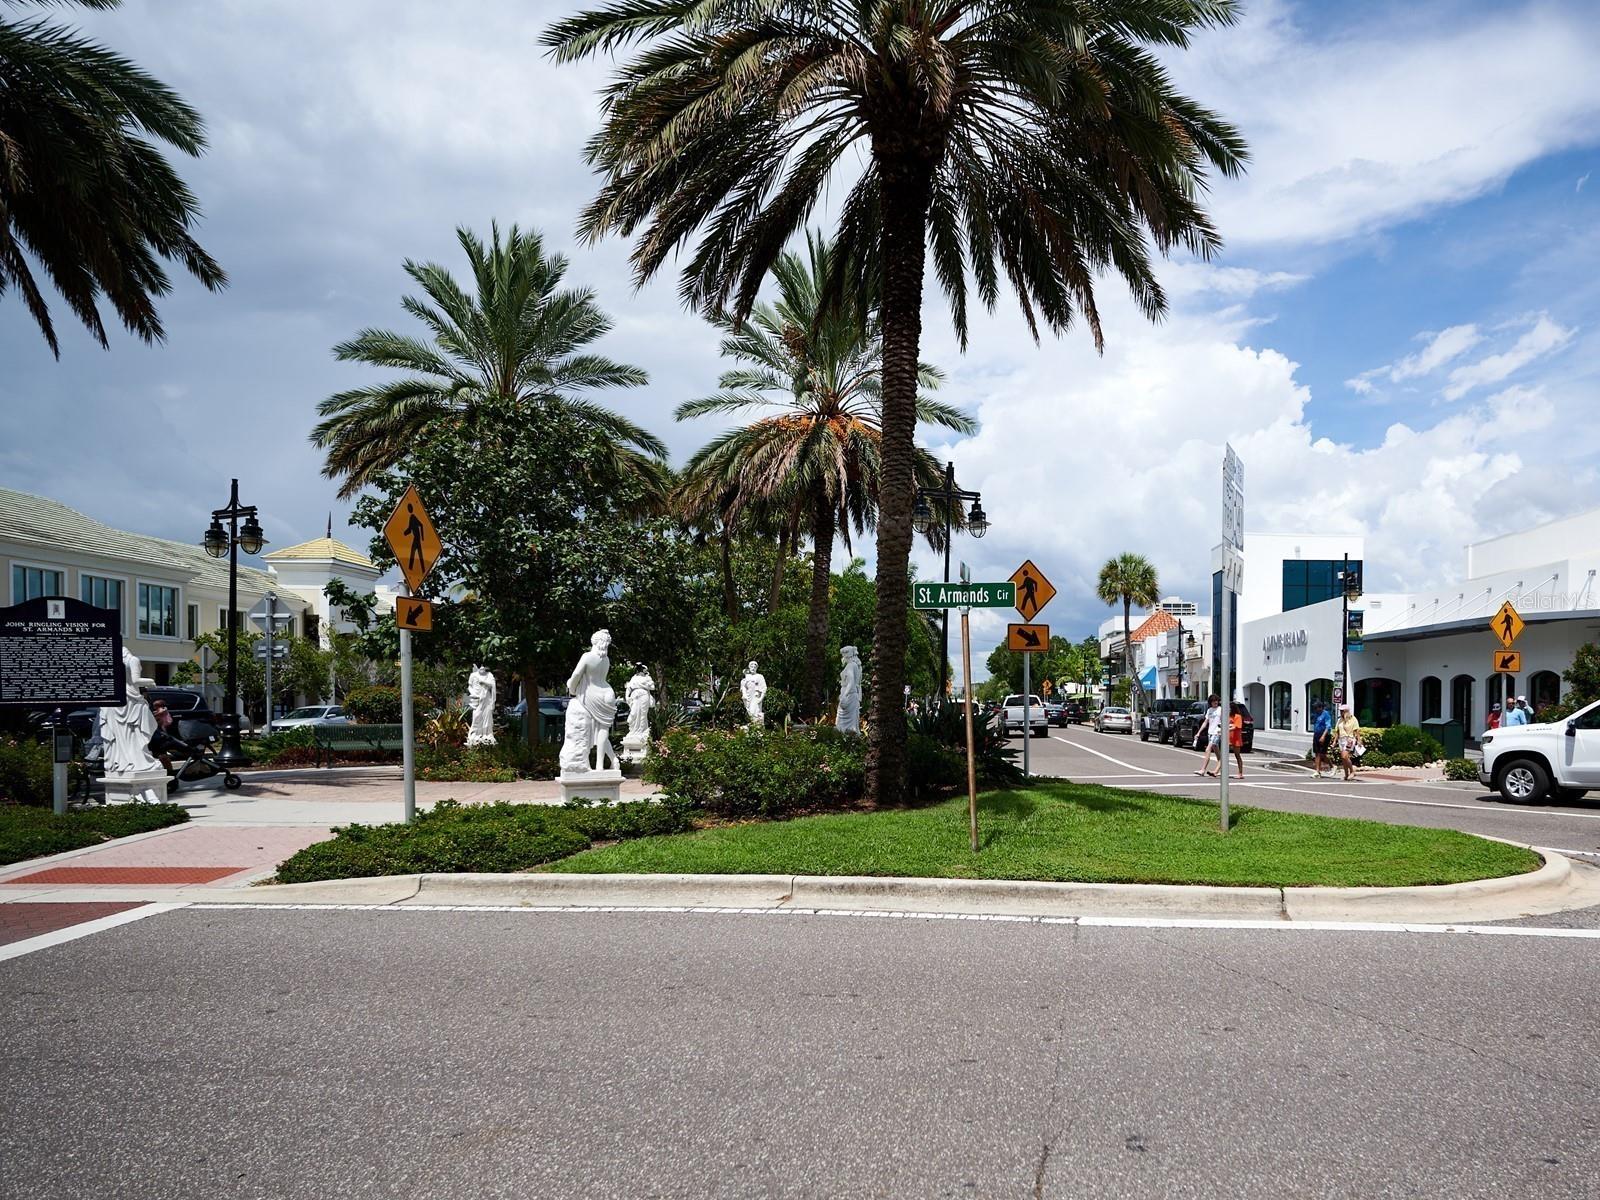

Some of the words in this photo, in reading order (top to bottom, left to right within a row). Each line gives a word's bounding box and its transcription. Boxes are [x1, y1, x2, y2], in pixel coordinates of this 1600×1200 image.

[919, 587, 934, 603] St.
[938, 587, 989, 603] Armands
[997, 589, 1009, 600] Cir
